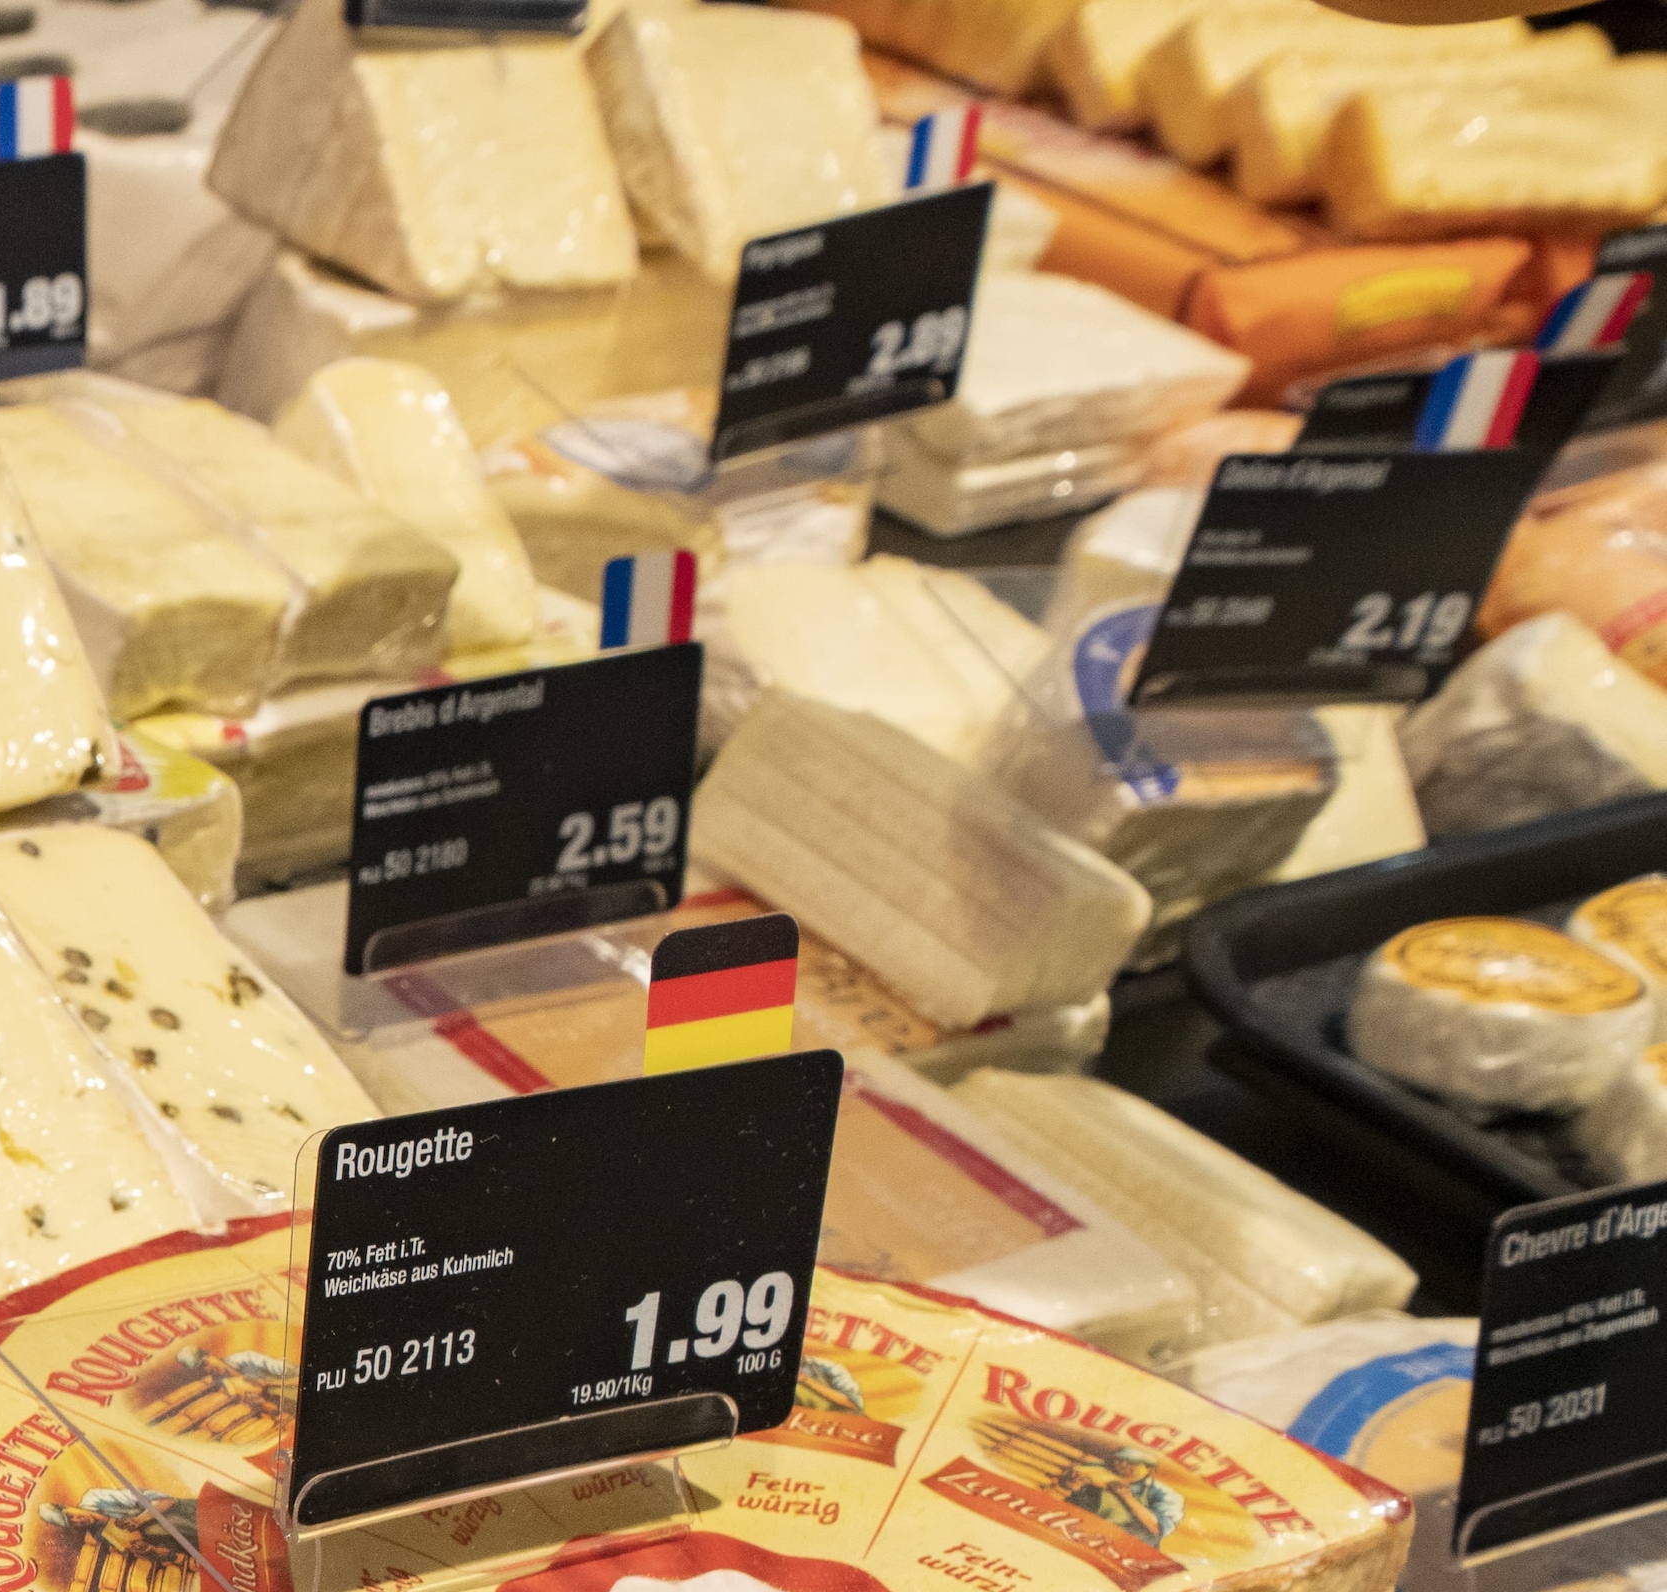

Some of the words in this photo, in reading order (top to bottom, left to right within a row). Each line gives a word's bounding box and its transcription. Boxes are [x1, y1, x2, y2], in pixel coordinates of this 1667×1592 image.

[557, 796, 681, 872] 2.59
[335, 1125, 474, 1181] Rougette
[326, 1249, 361, 1272] 70%
[366, 1241, 397, 1265] Fett
[1498, 1222, 1589, 1268] Chevre
[324, 1267, 407, 1299] Weichkäse
[411, 1261, 439, 1283] aus
[442, 1247, 515, 1277] Kuhmilch
[45, 1286, 280, 1407] ROUGETTE
[625, 1271, 795, 1372] 1.99
[316, 1368, 347, 1393] PLU
[354, 1345, 392, 1385] 50
[400, 1329, 477, 1376] 2113
[736, 1354, 767, 1376] 100
[768, 1350, 782, 1371] G
[571, 1374, 654, 1405] 19.90/1Kg
[1508, 1401, 1542, 1439] 50
[1543, 1382, 1608, 1429] 2031
[982, 1364, 1322, 1539] ROUGETTE
[737, 1494, 841, 1527] würzig
[747, 1471, 827, 1497] Fein-
[937, 1464, 1153, 1576] Landkäse
[945, 1541, 1034, 1586] Fein-
